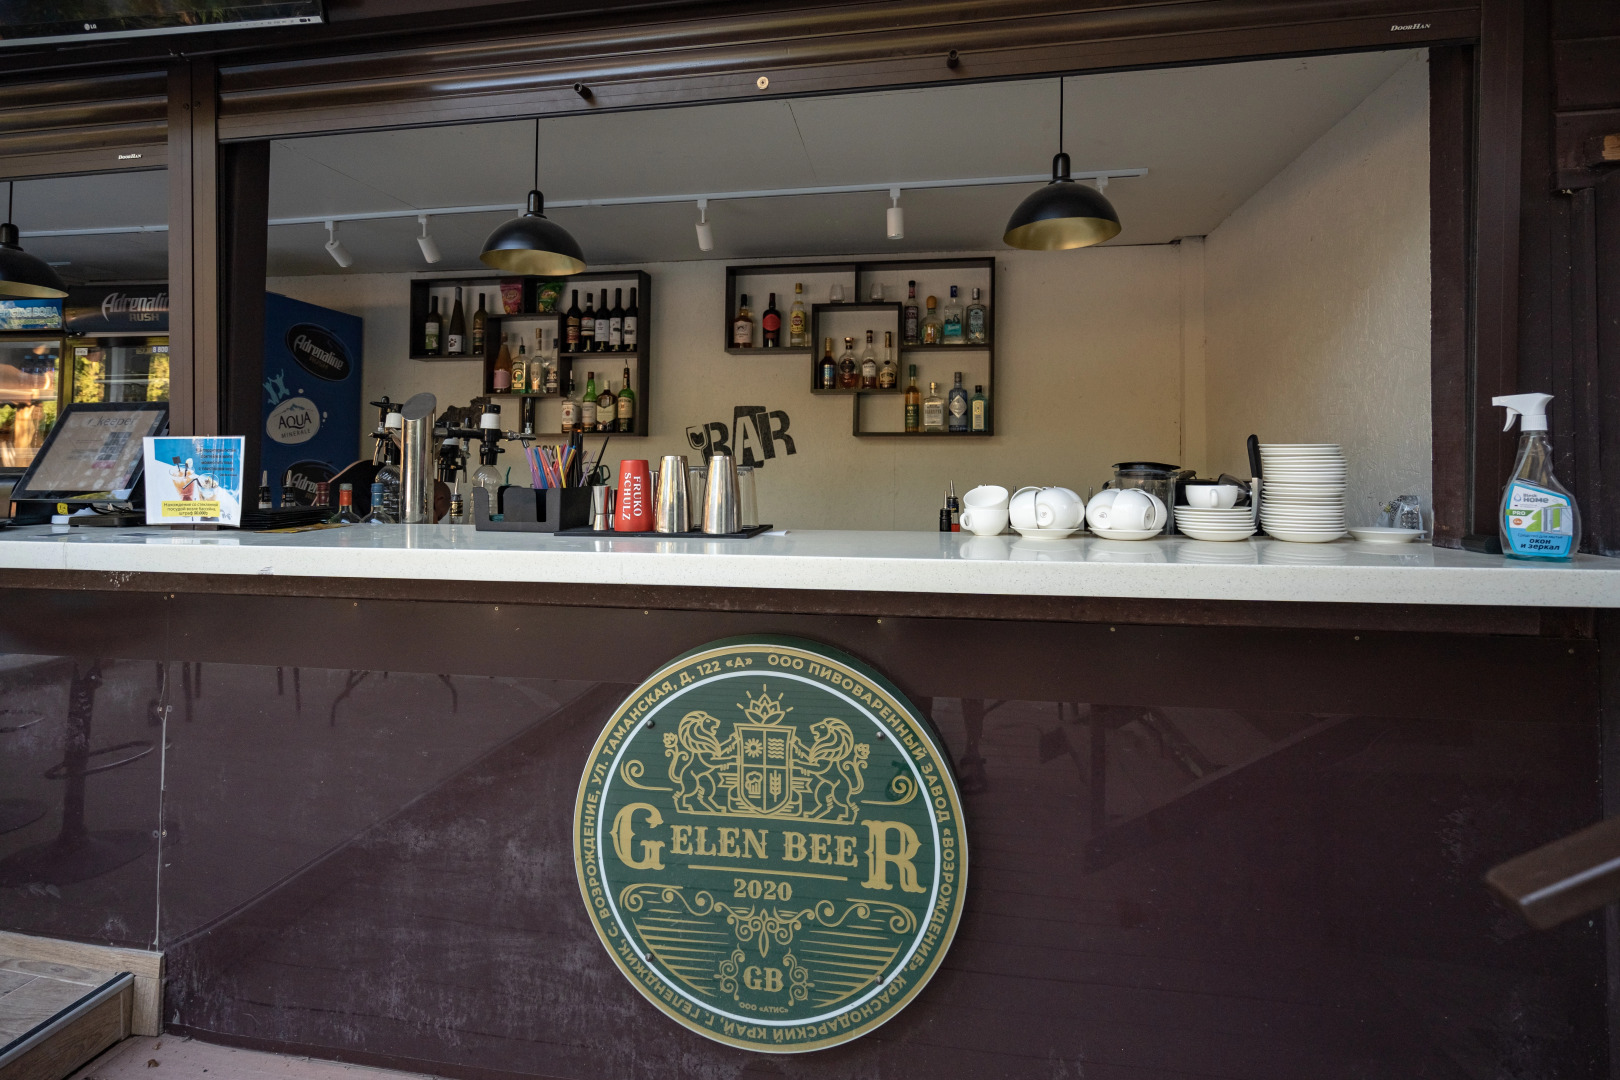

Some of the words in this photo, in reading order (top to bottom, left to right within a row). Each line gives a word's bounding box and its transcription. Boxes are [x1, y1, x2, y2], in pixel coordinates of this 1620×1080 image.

[102, 292, 169, 321] Adrenalin
[129, 312, 160, 322] RUSH
[294, 334, 344, 370] Adrenaline
[278, 412, 312, 430] AQUA
[281, 428, 311, 438] MINERALE
[703, 406, 797, 468] BAR
[292, 473, 318, 494] Adren
[622, 472, 631, 521] SCHULZ
[633, 476, 642, 517] FRUKO
[696, 658, 721, 678] 122
[724, 654, 752, 670] «А»
[767, 655, 804, 670] ООО
[677, 668, 695, 686] Д.
[602, 678, 678, 757] ТАМАНСКАЯ,
[808, 662, 927, 760] ПИВОВАРЕННЫЙ
[591, 758, 609, 785] УЛ.
[920, 762, 950, 822] ЗАВОД
[583, 789, 611, 919] ВОЗРОЖДЕНИЕ,
[609, 802, 768, 870] GELEN
[782, 820, 926, 894] BEER
[734, 878, 793, 902] 2020
[605, 920, 620, 938] С.
[615, 938, 700, 1018] ГЕЛЕНДЖИК,
[743, 964, 784, 993] GB
[702, 1011, 715, 1026] Г.
[739, 1002, 757, 1012] ООО
[773, 974, 907, 1041] КРАСНОДАРСКИЙ
[717, 1017, 766, 1039] КРАЙ,
